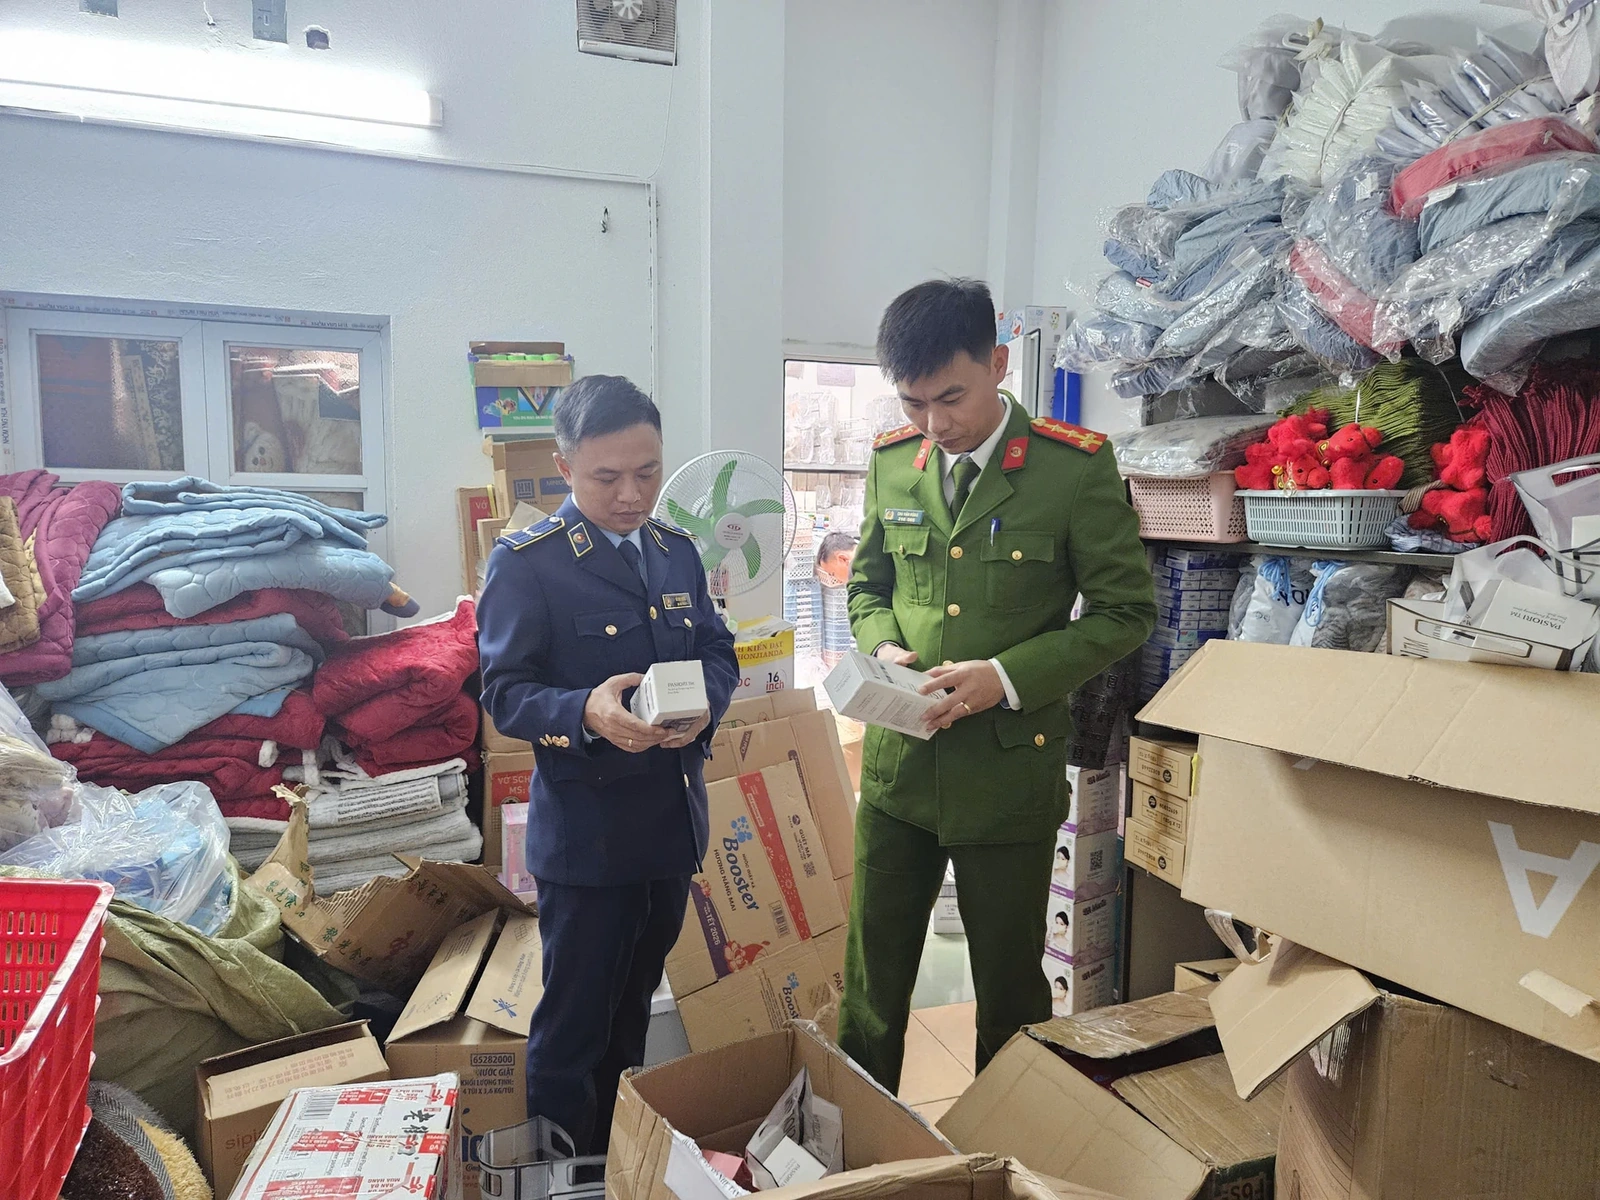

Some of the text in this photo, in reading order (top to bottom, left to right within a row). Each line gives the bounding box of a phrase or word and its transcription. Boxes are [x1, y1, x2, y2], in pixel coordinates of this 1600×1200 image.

[1522, 615, 1562, 631] PASIORI
[737, 649, 784, 660] HONJIANDA
[768, 671, 780, 683] 16
[766, 680, 785, 691] inch
[512, 775, 530, 784] SCH
[722, 837, 759, 910] Booster
[727, 896, 737, 912] MAI
[710, 926, 721, 946] 2026
[782, 986, 800, 1020] Boost
[472, 1055, 513, 1064] 65282000
